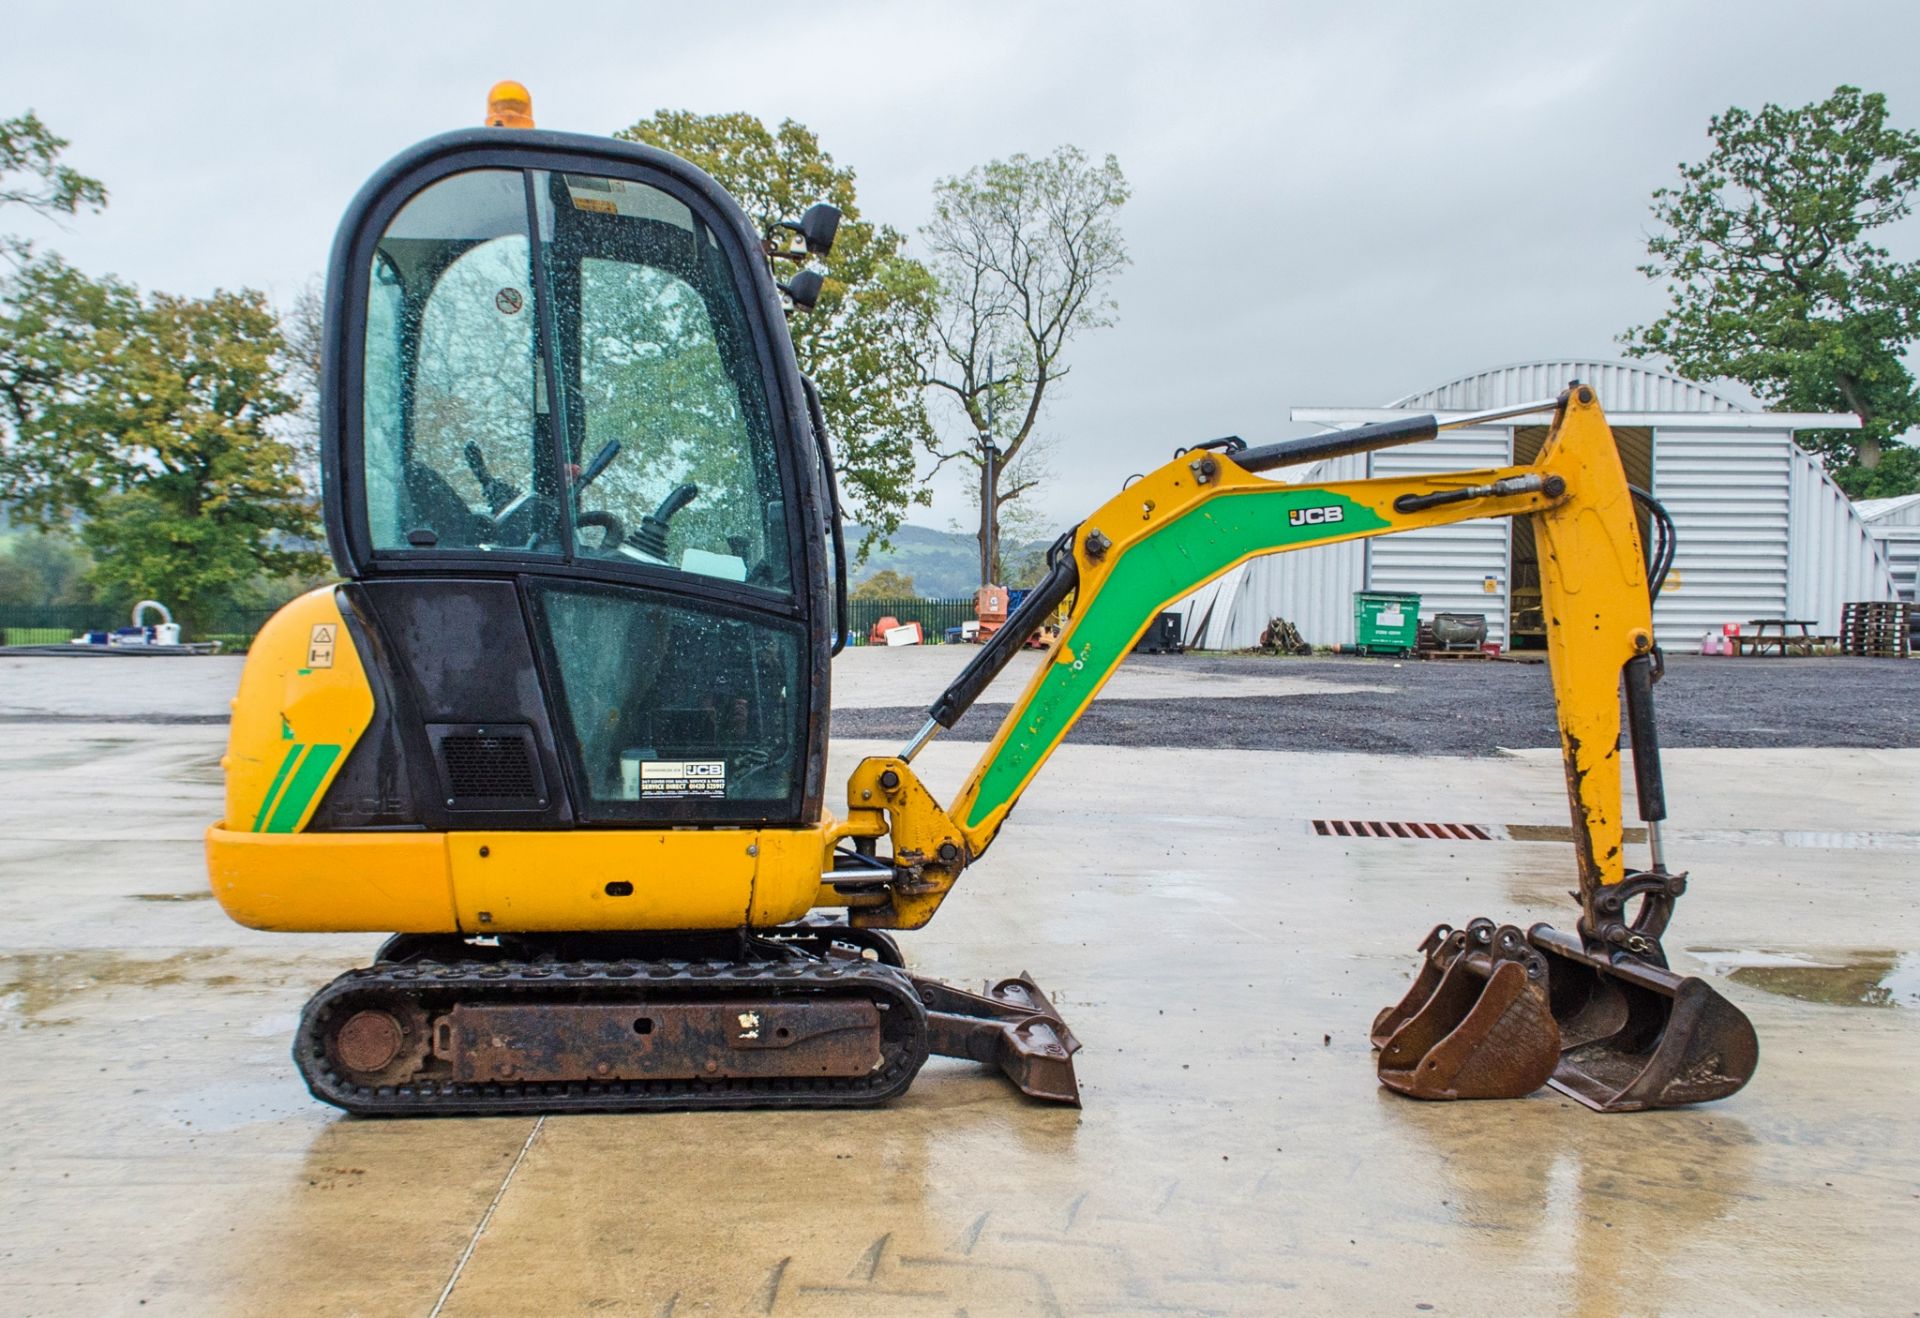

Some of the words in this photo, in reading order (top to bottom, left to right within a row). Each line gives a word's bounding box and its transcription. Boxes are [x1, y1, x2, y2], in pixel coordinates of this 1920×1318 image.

[1289, 506, 1343, 526] JCB
[686, 765, 722, 775] JCB
[334, 799, 409, 815] JCB
